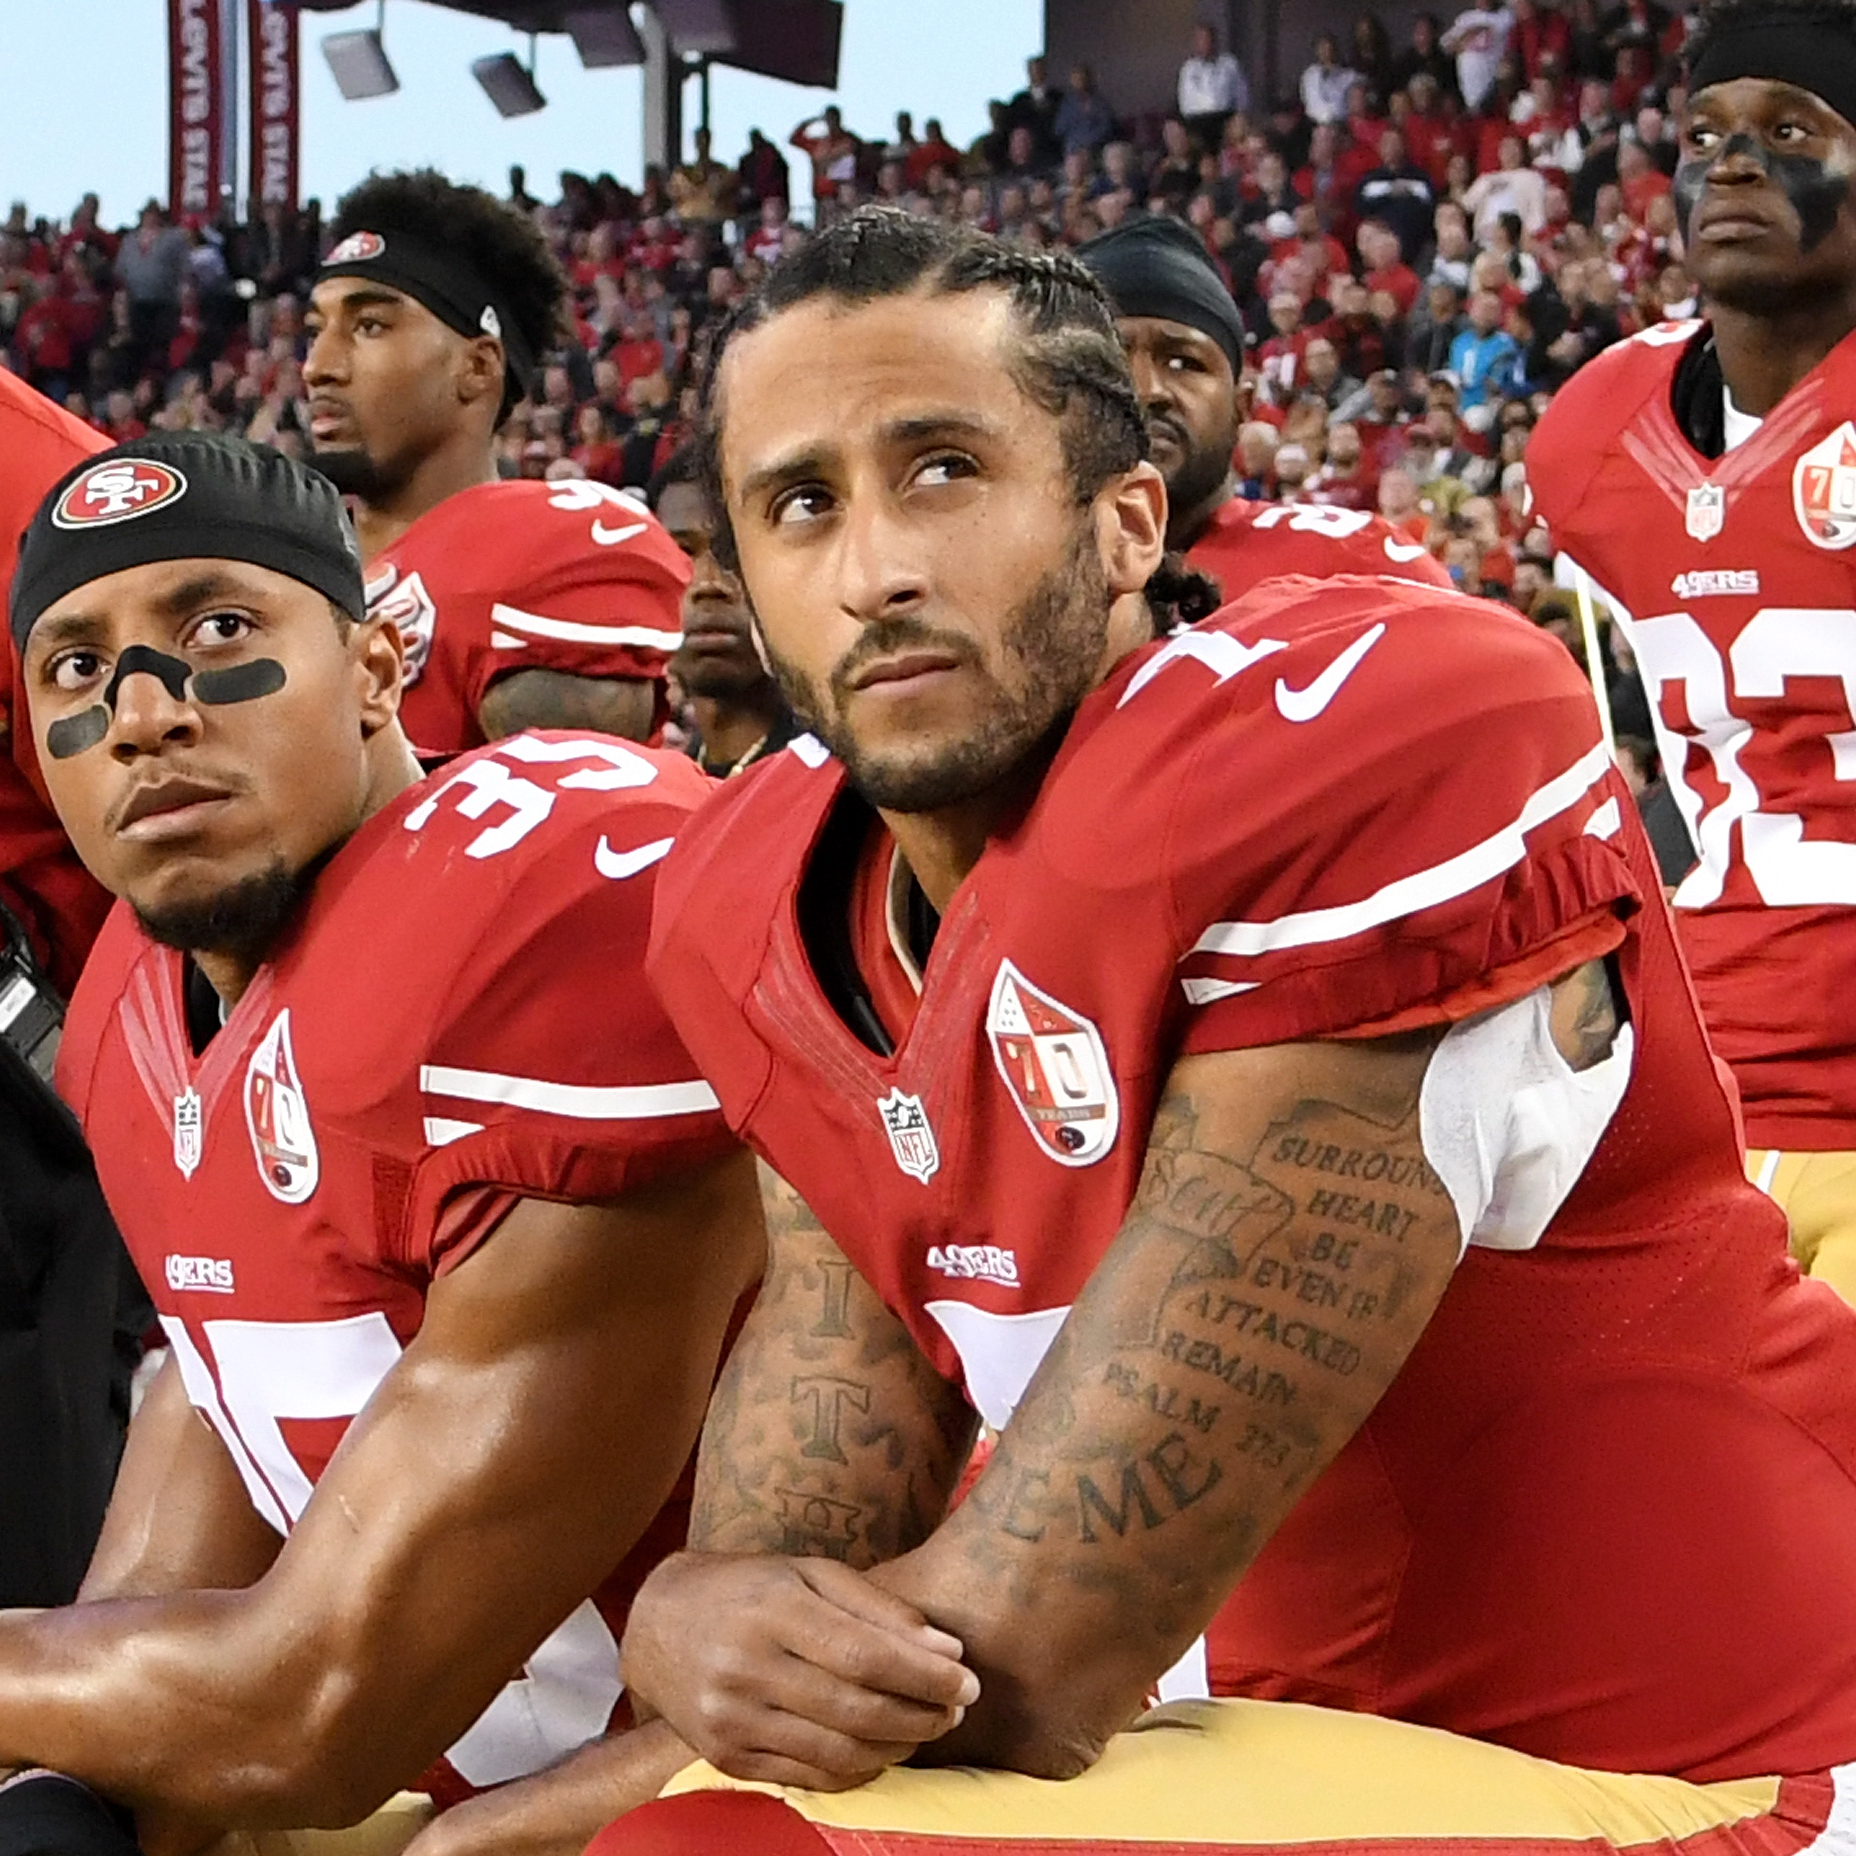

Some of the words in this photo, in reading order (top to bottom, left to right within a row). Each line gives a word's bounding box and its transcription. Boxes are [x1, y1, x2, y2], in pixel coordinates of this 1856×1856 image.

[1306, 1188, 1421, 1243] HEART
[927, 1243, 1021, 1287] 49ERS
[1186, 1289, 1363, 1378] ATTACKED
